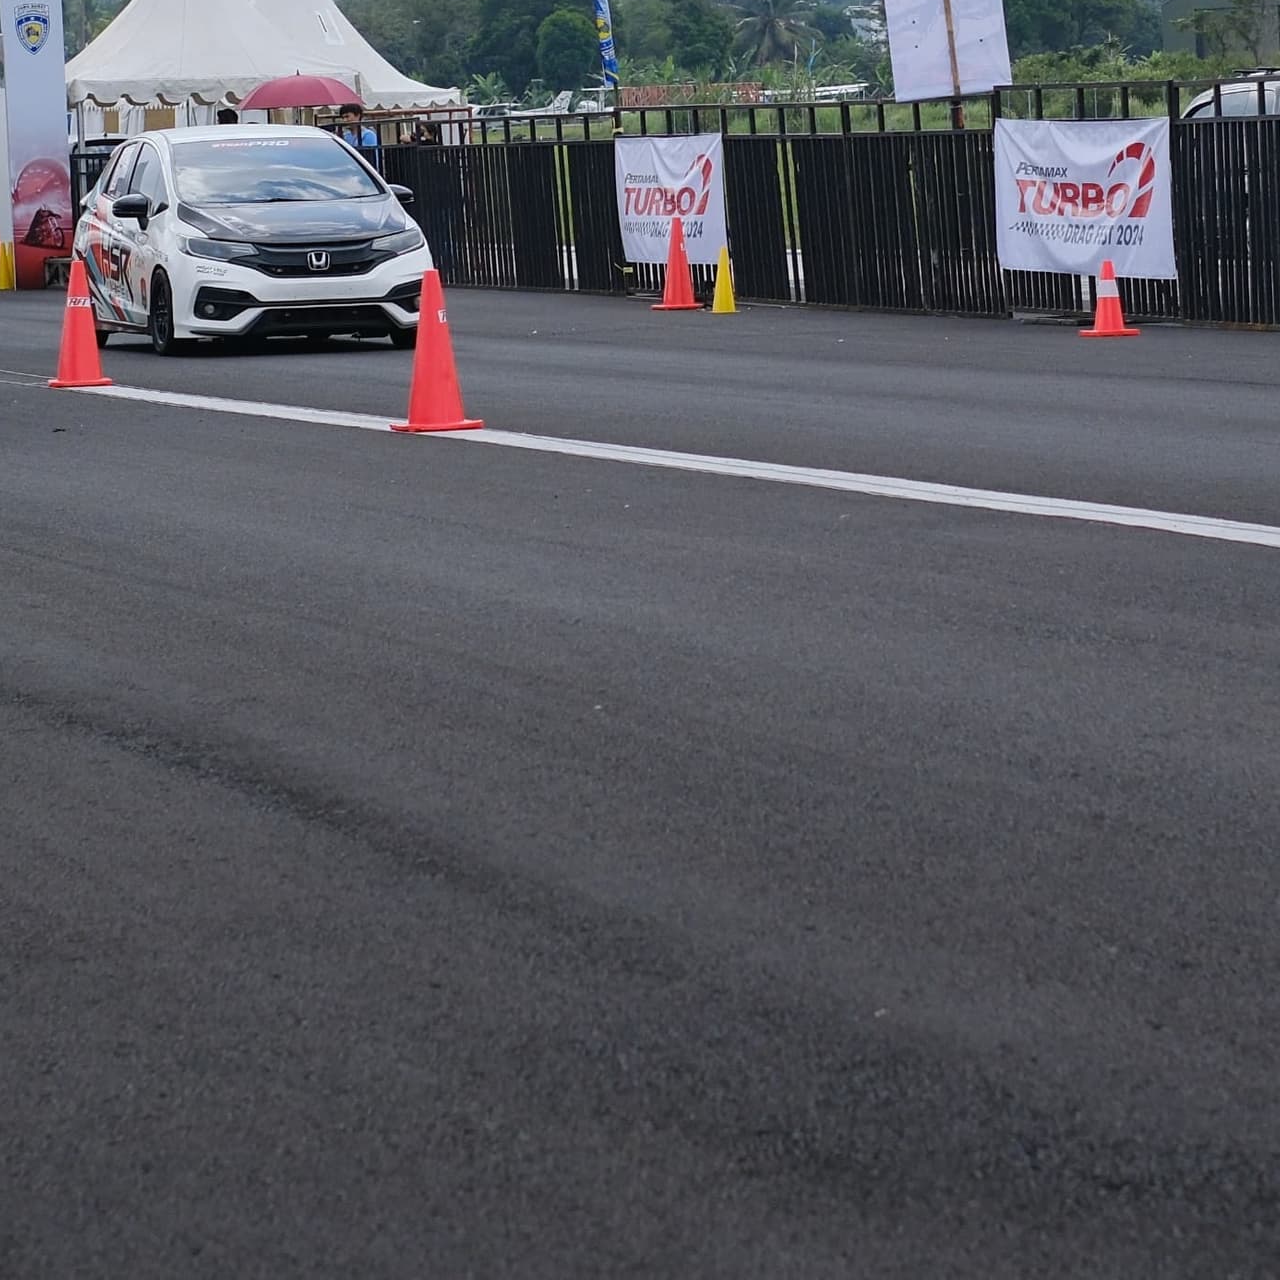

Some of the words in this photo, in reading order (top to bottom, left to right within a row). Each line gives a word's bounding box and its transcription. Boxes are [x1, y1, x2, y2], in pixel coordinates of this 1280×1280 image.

[624, 186, 696, 216] TURBO
[1015, 178, 1131, 218] TURBO
[1063, 225, 1095, 245] DRAG
[1116, 225, 1146, 246] 2024
